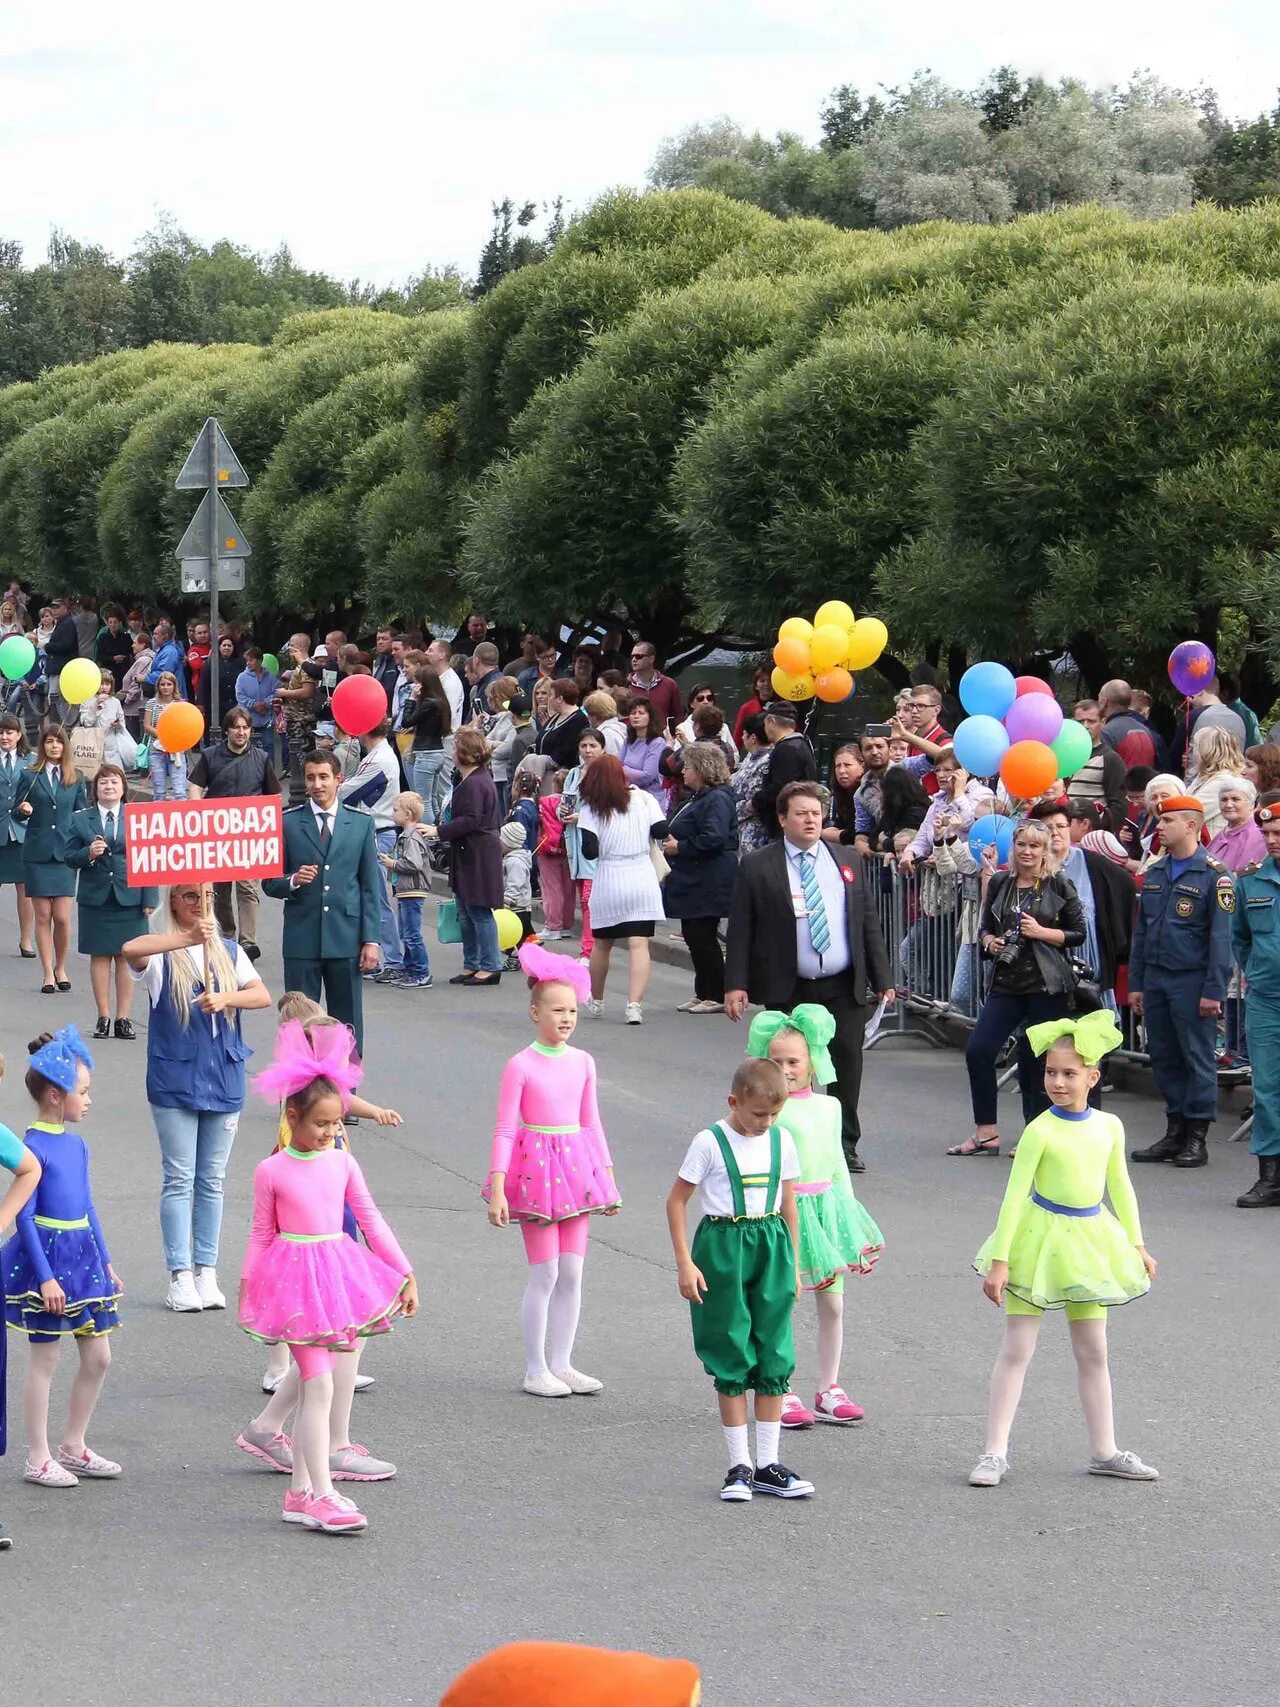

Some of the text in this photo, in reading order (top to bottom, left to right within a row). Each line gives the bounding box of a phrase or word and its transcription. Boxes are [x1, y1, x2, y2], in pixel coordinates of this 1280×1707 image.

[73, 751, 98, 759] FLARE
[129, 805, 278, 841] НАЛОГОВАЯ
[131, 836, 280, 874] ИНСПЕКЦИЯ
